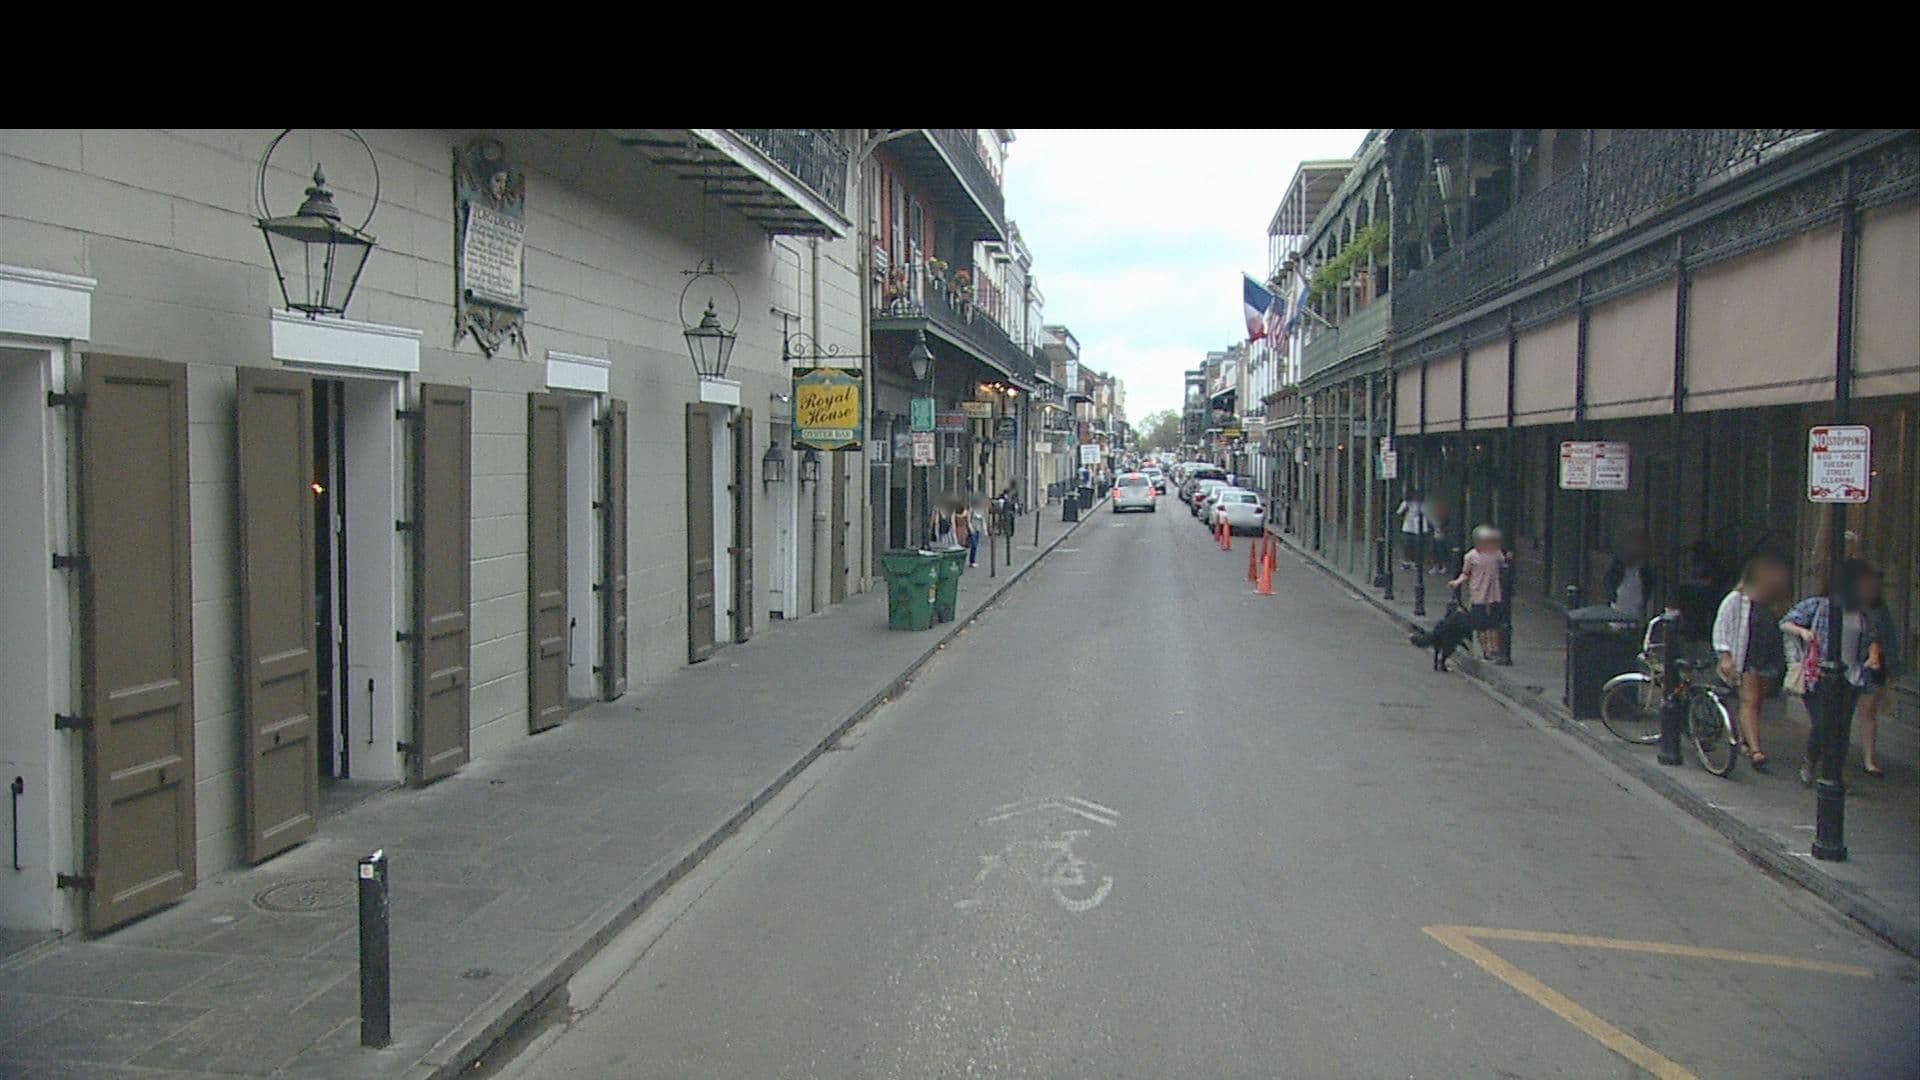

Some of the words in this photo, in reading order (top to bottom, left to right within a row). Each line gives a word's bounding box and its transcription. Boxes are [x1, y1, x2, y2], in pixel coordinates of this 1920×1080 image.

[800, 386, 851, 411] Royal
[804, 408, 854, 425] House
[803, 430, 833, 438] OYSTER
[835, 430, 850, 438] BAR
[1827, 436, 1866, 446] STOPPING
